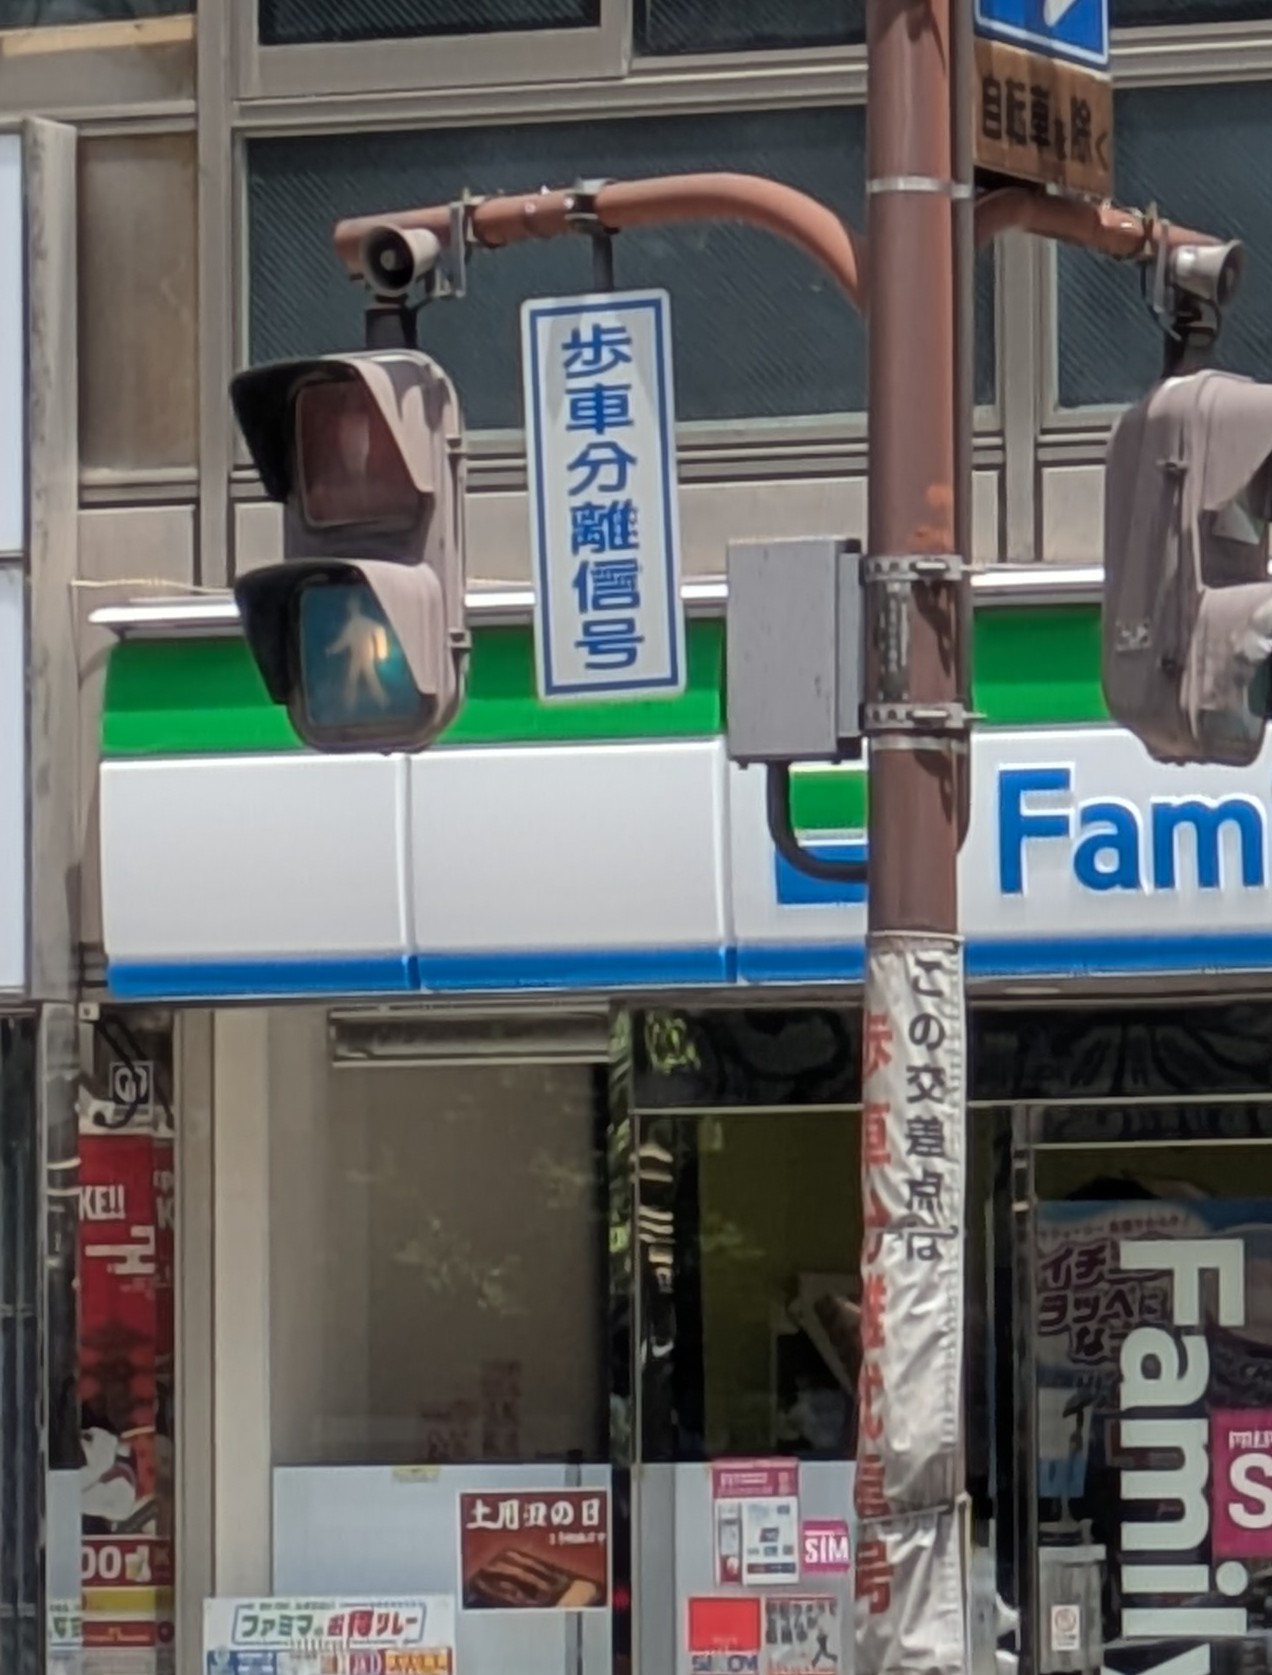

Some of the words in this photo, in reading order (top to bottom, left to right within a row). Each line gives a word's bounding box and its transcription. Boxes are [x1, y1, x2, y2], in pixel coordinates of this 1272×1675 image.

[561, 324, 645, 671] 歩車分離信号
[906, 958, 947, 1262] この交差点は
[804, 1535, 849, 1564] SIM
